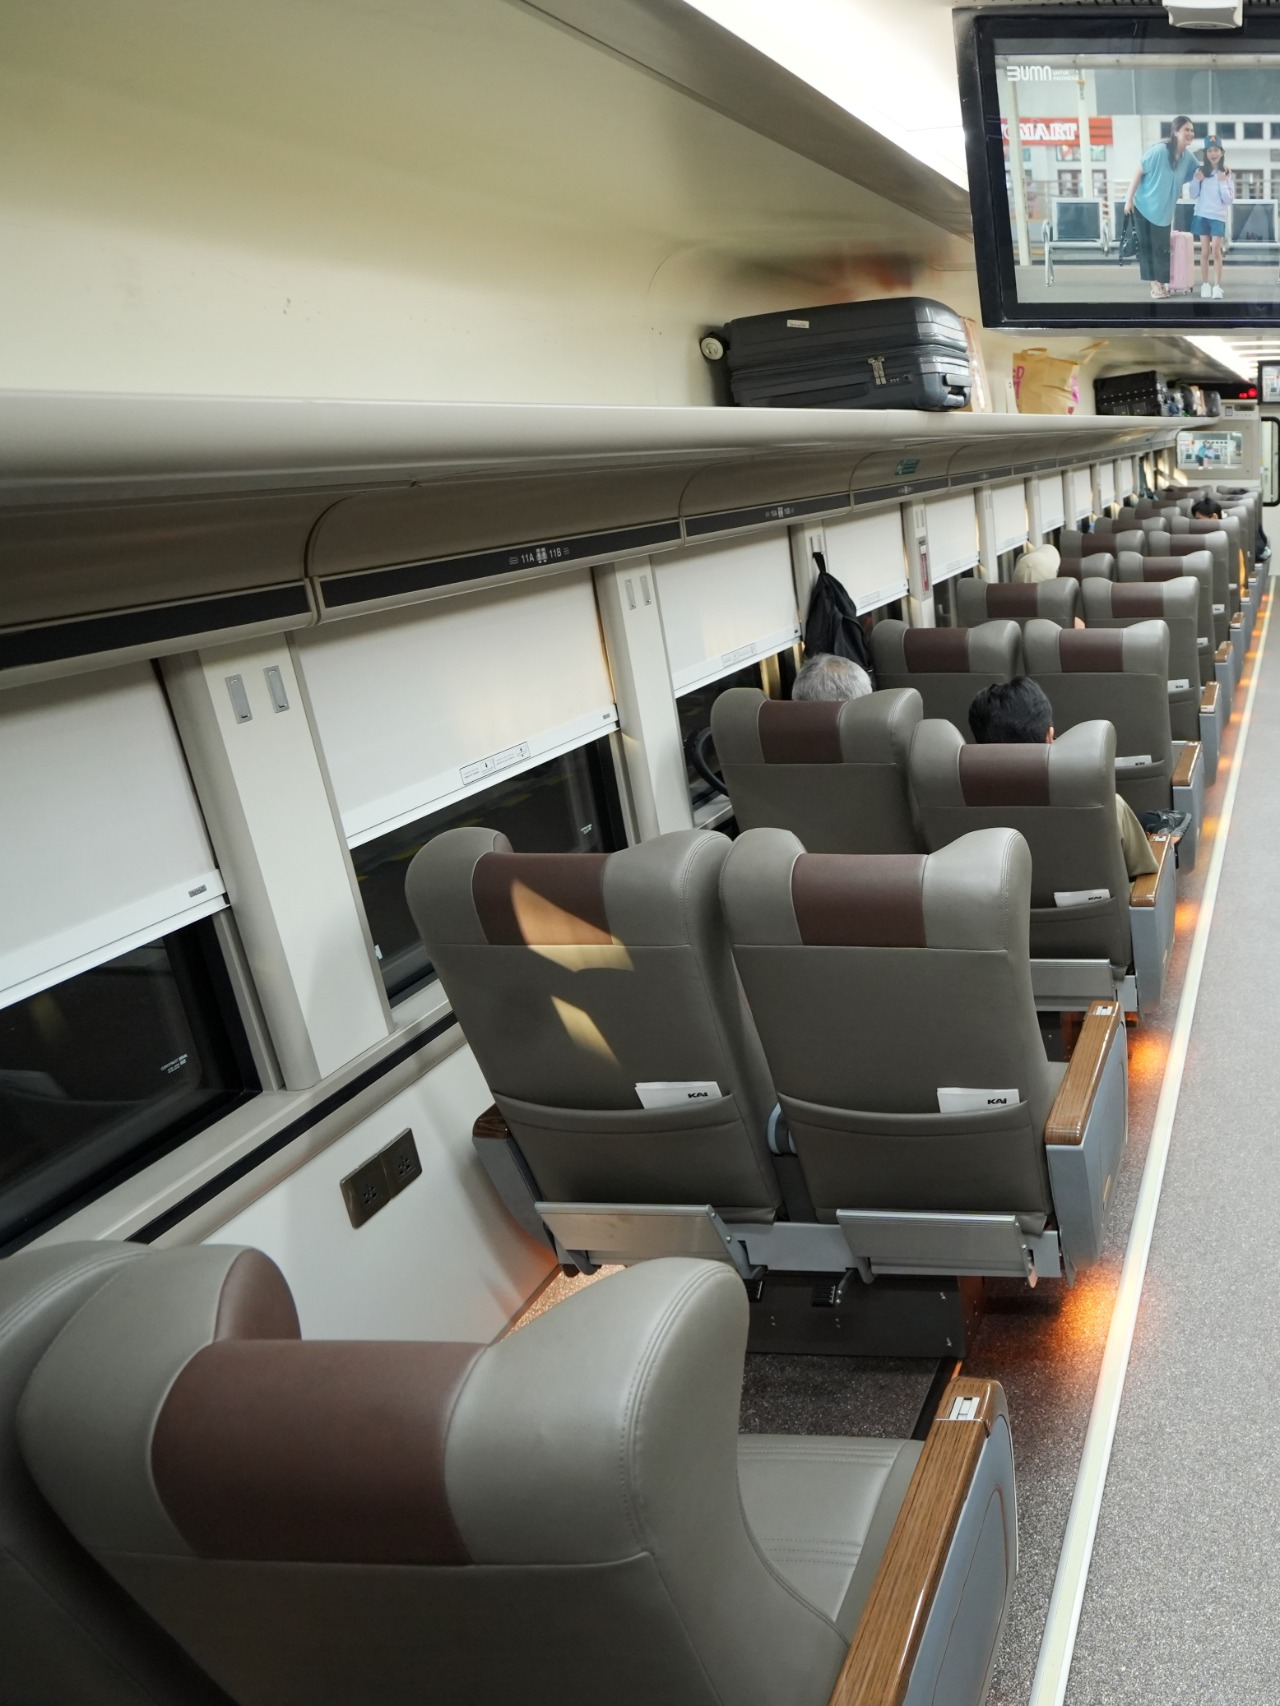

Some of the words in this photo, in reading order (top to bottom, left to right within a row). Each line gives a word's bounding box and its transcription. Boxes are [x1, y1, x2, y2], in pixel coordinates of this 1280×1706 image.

[1006, 65, 1051, 81] BUMN
[521, 553, 535, 563] 11A
[549, 547, 562, 558] 11B
